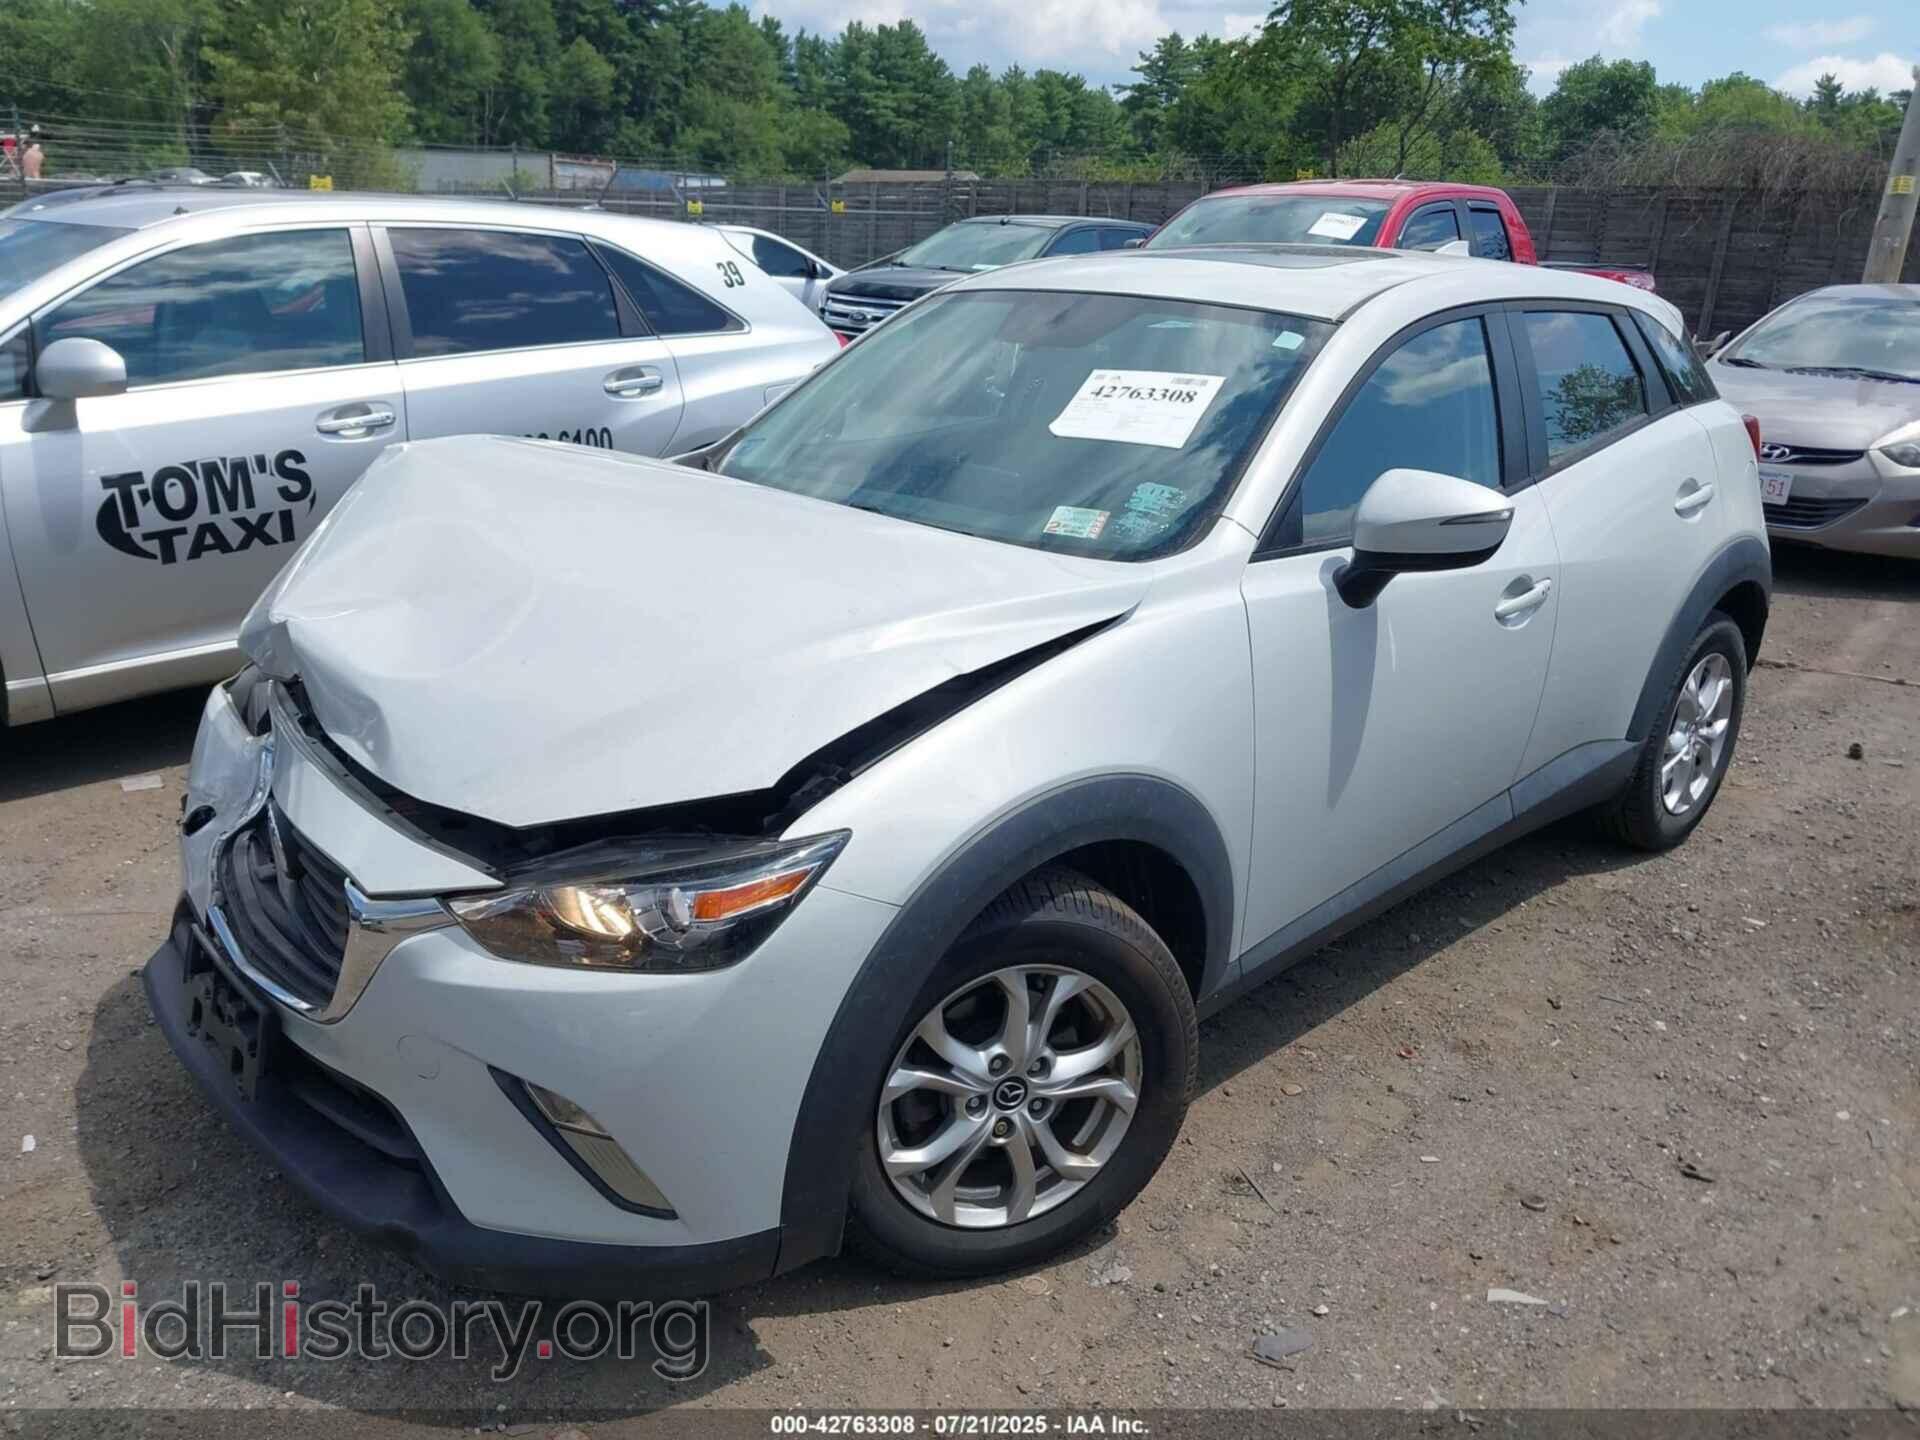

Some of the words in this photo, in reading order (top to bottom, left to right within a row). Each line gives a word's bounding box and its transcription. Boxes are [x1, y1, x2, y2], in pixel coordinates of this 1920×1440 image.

[716, 260, 745, 288] 39
[1091, 385, 1198, 403] 42763308
[100, 449, 313, 529] TOM'S
[141, 508, 296, 565] TAXI
